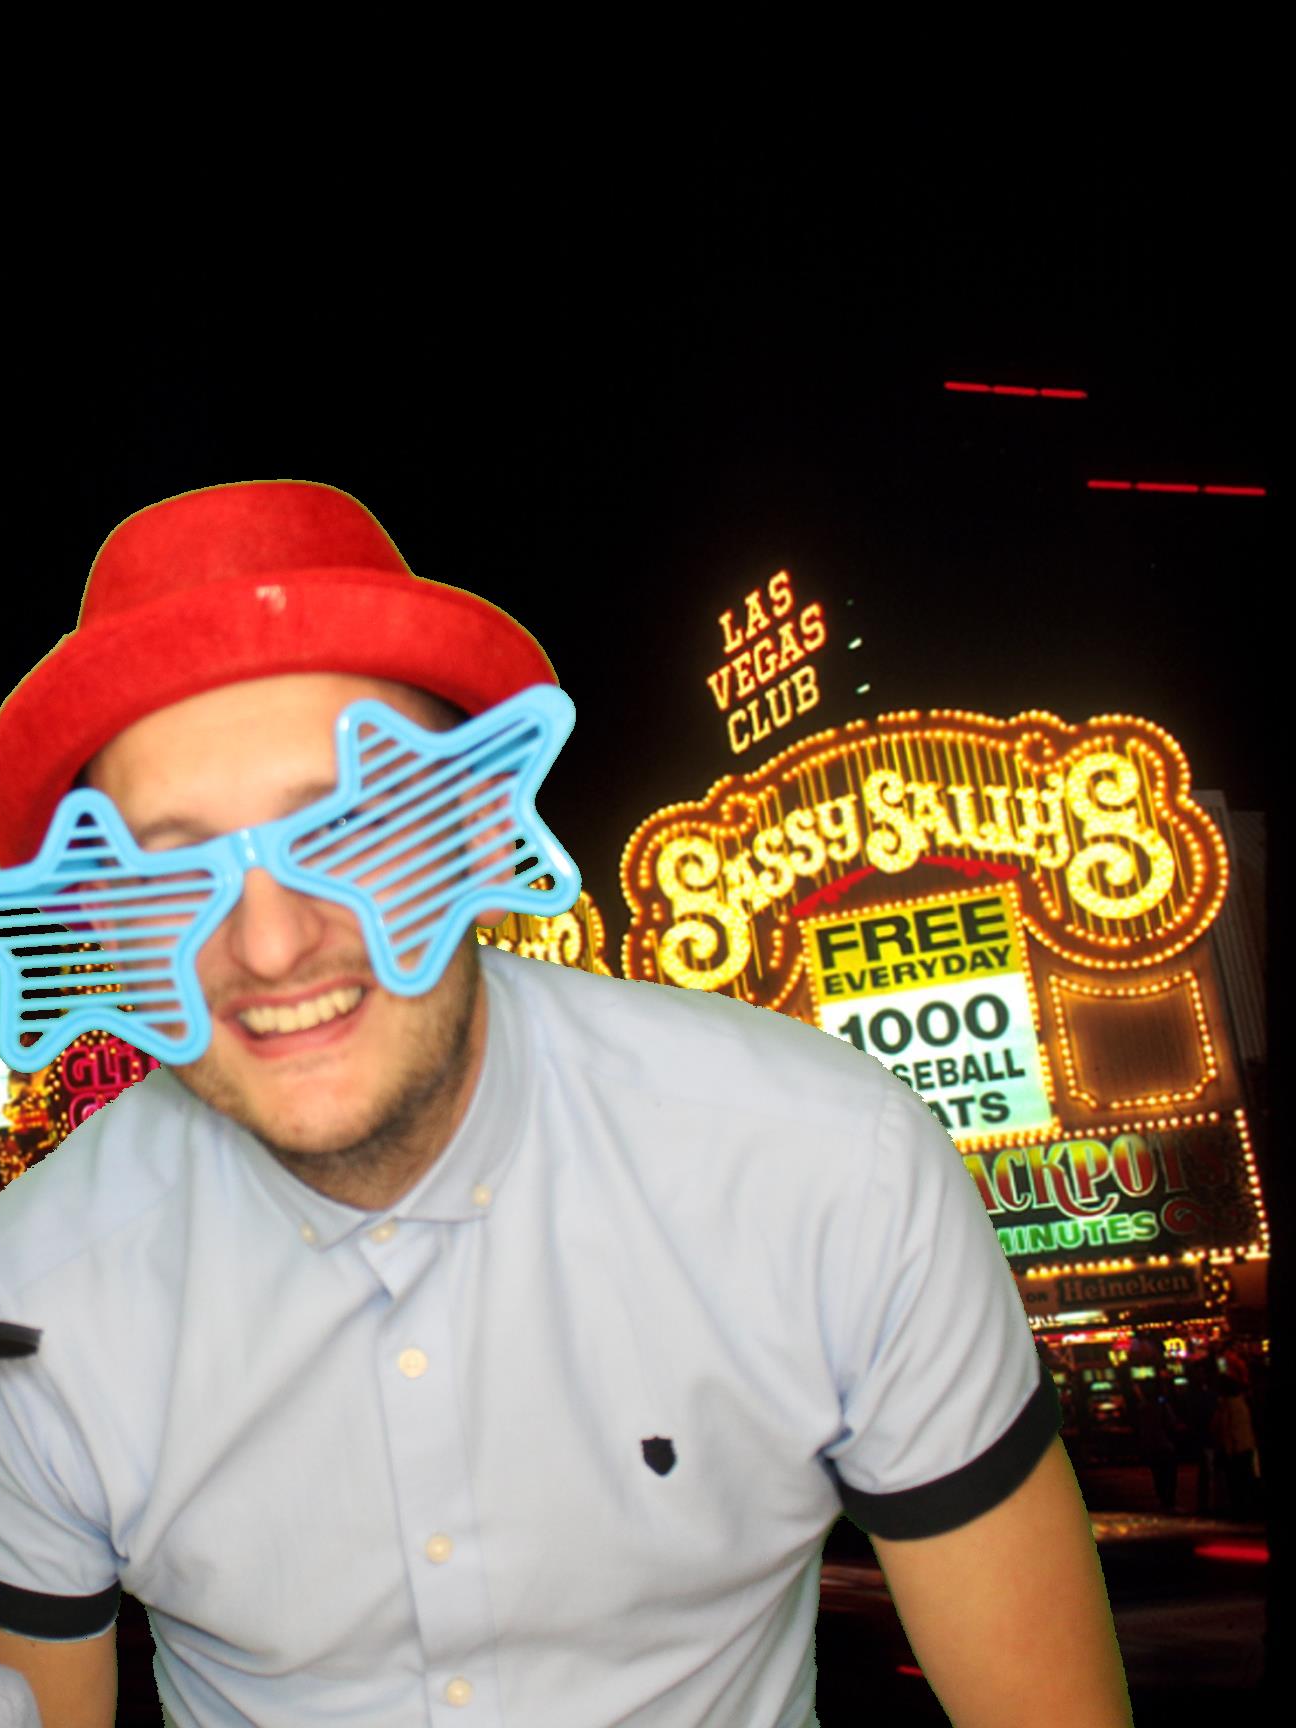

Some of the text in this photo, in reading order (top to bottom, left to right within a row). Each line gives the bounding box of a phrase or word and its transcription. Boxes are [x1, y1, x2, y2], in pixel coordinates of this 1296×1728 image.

[717, 570, 794, 652] LAS
[706, 603, 826, 710] VEGAS
[725, 665, 821, 754] CLUB
[815, 896, 1009, 970] FREE
[823, 945, 1012, 996] EVERYDAY
[838, 993, 1010, 1054] 1000
[1062, 1273, 1191, 1303] Heineken
